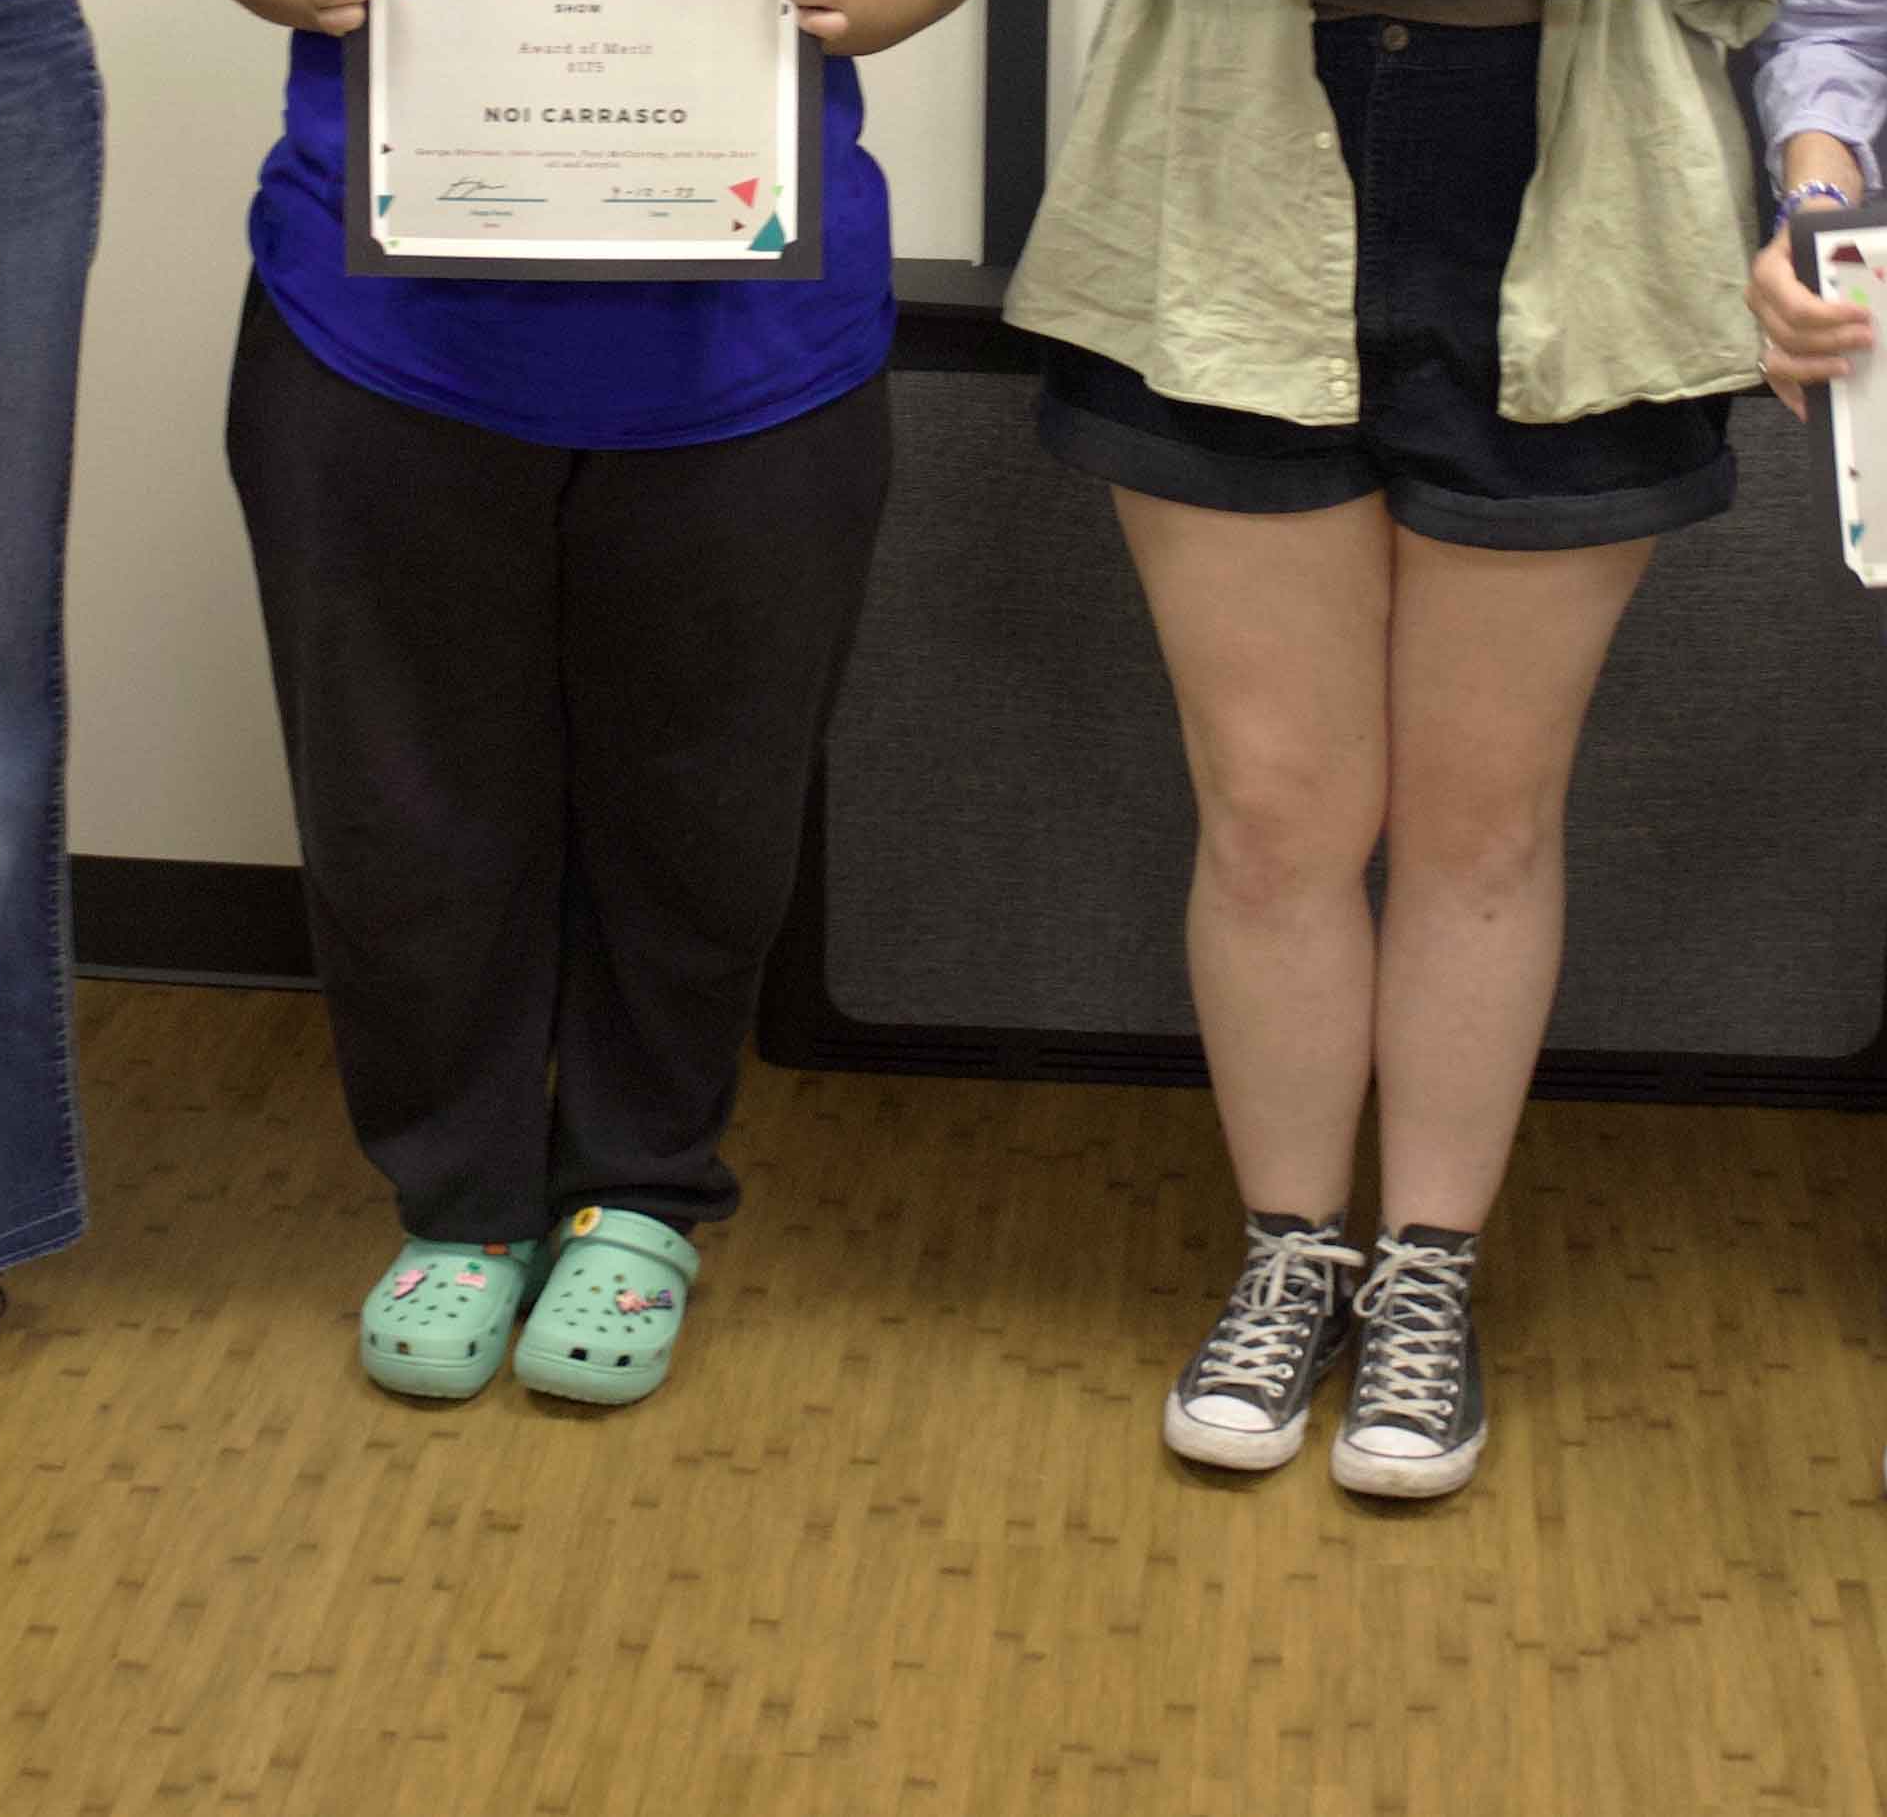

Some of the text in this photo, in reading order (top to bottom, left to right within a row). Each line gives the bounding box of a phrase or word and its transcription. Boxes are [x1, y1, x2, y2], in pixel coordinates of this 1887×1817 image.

[554, 3, 601, 14] SHOW
[517, 43, 653, 55] Award of Merit
[483, 106, 689, 124] NOI CARRASCO
